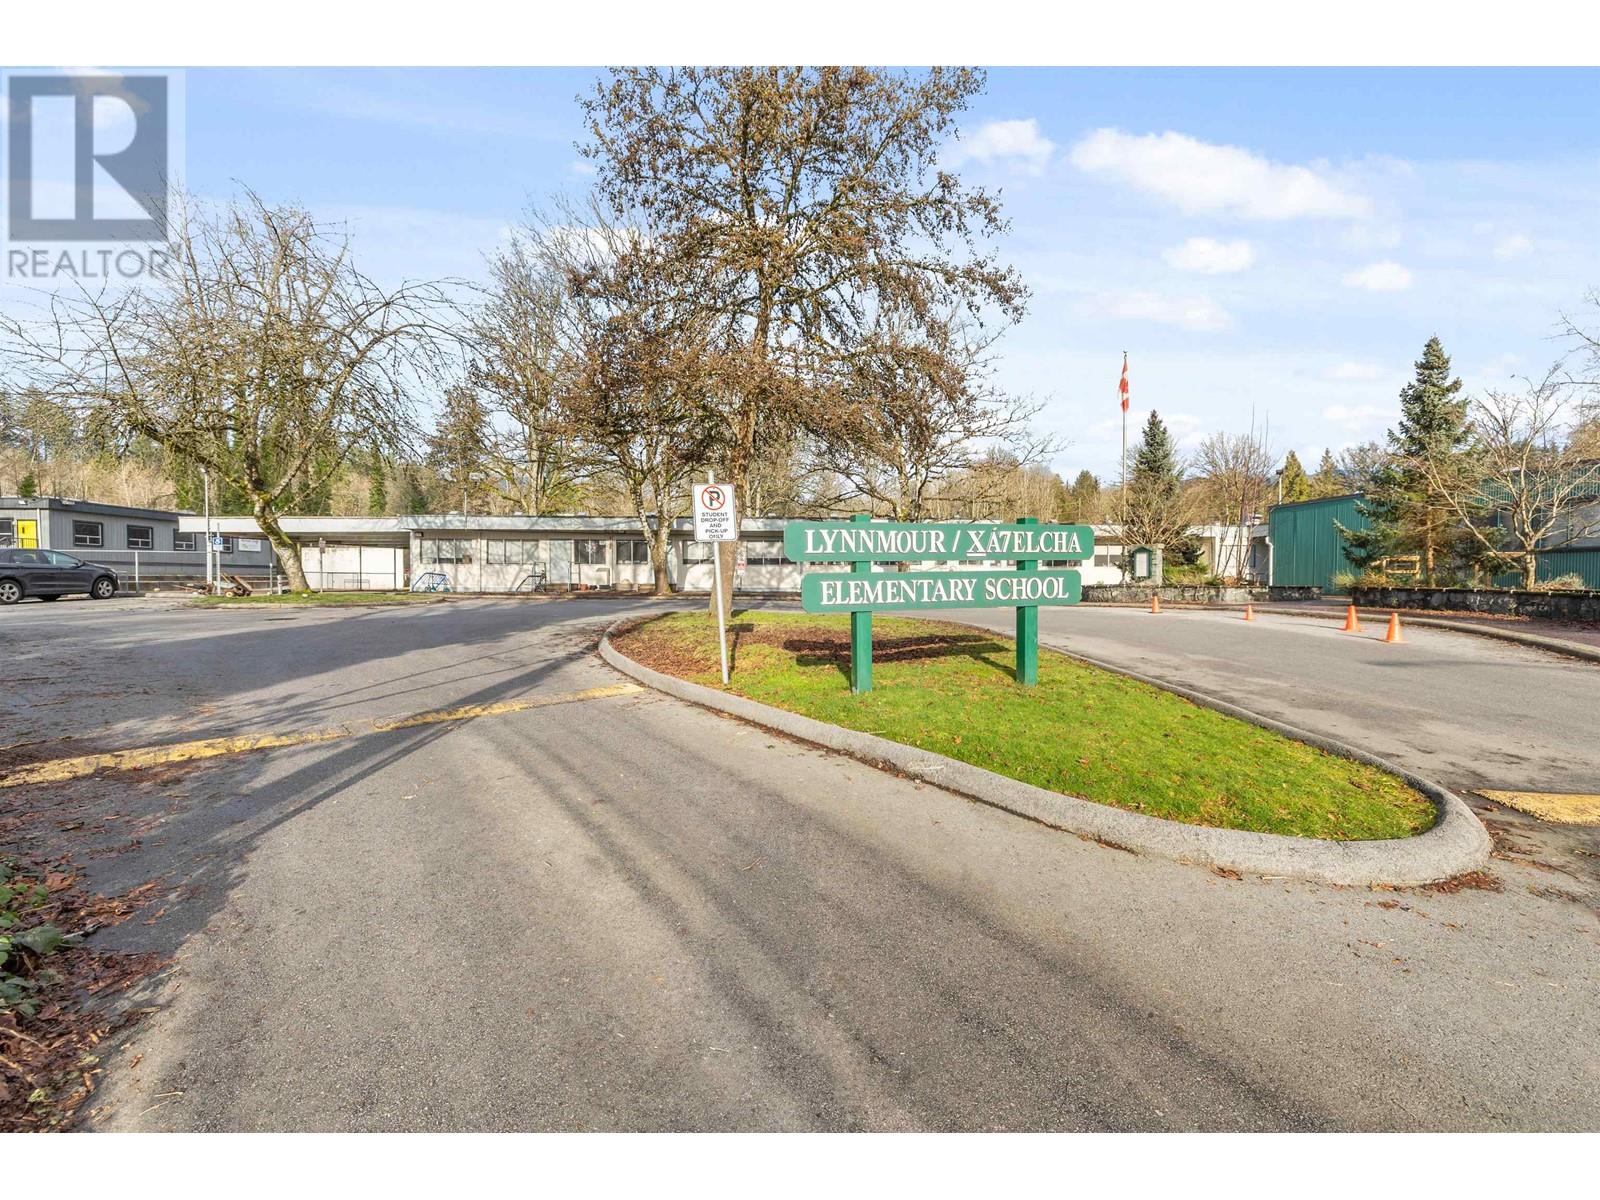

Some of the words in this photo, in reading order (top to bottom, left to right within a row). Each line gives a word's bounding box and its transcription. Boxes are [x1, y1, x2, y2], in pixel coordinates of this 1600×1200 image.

[804, 529, 946, 554] LYNNMOUR
[820, 578, 977, 606] ELEMENTARY
[984, 577, 1069, 601] SCHOOL
